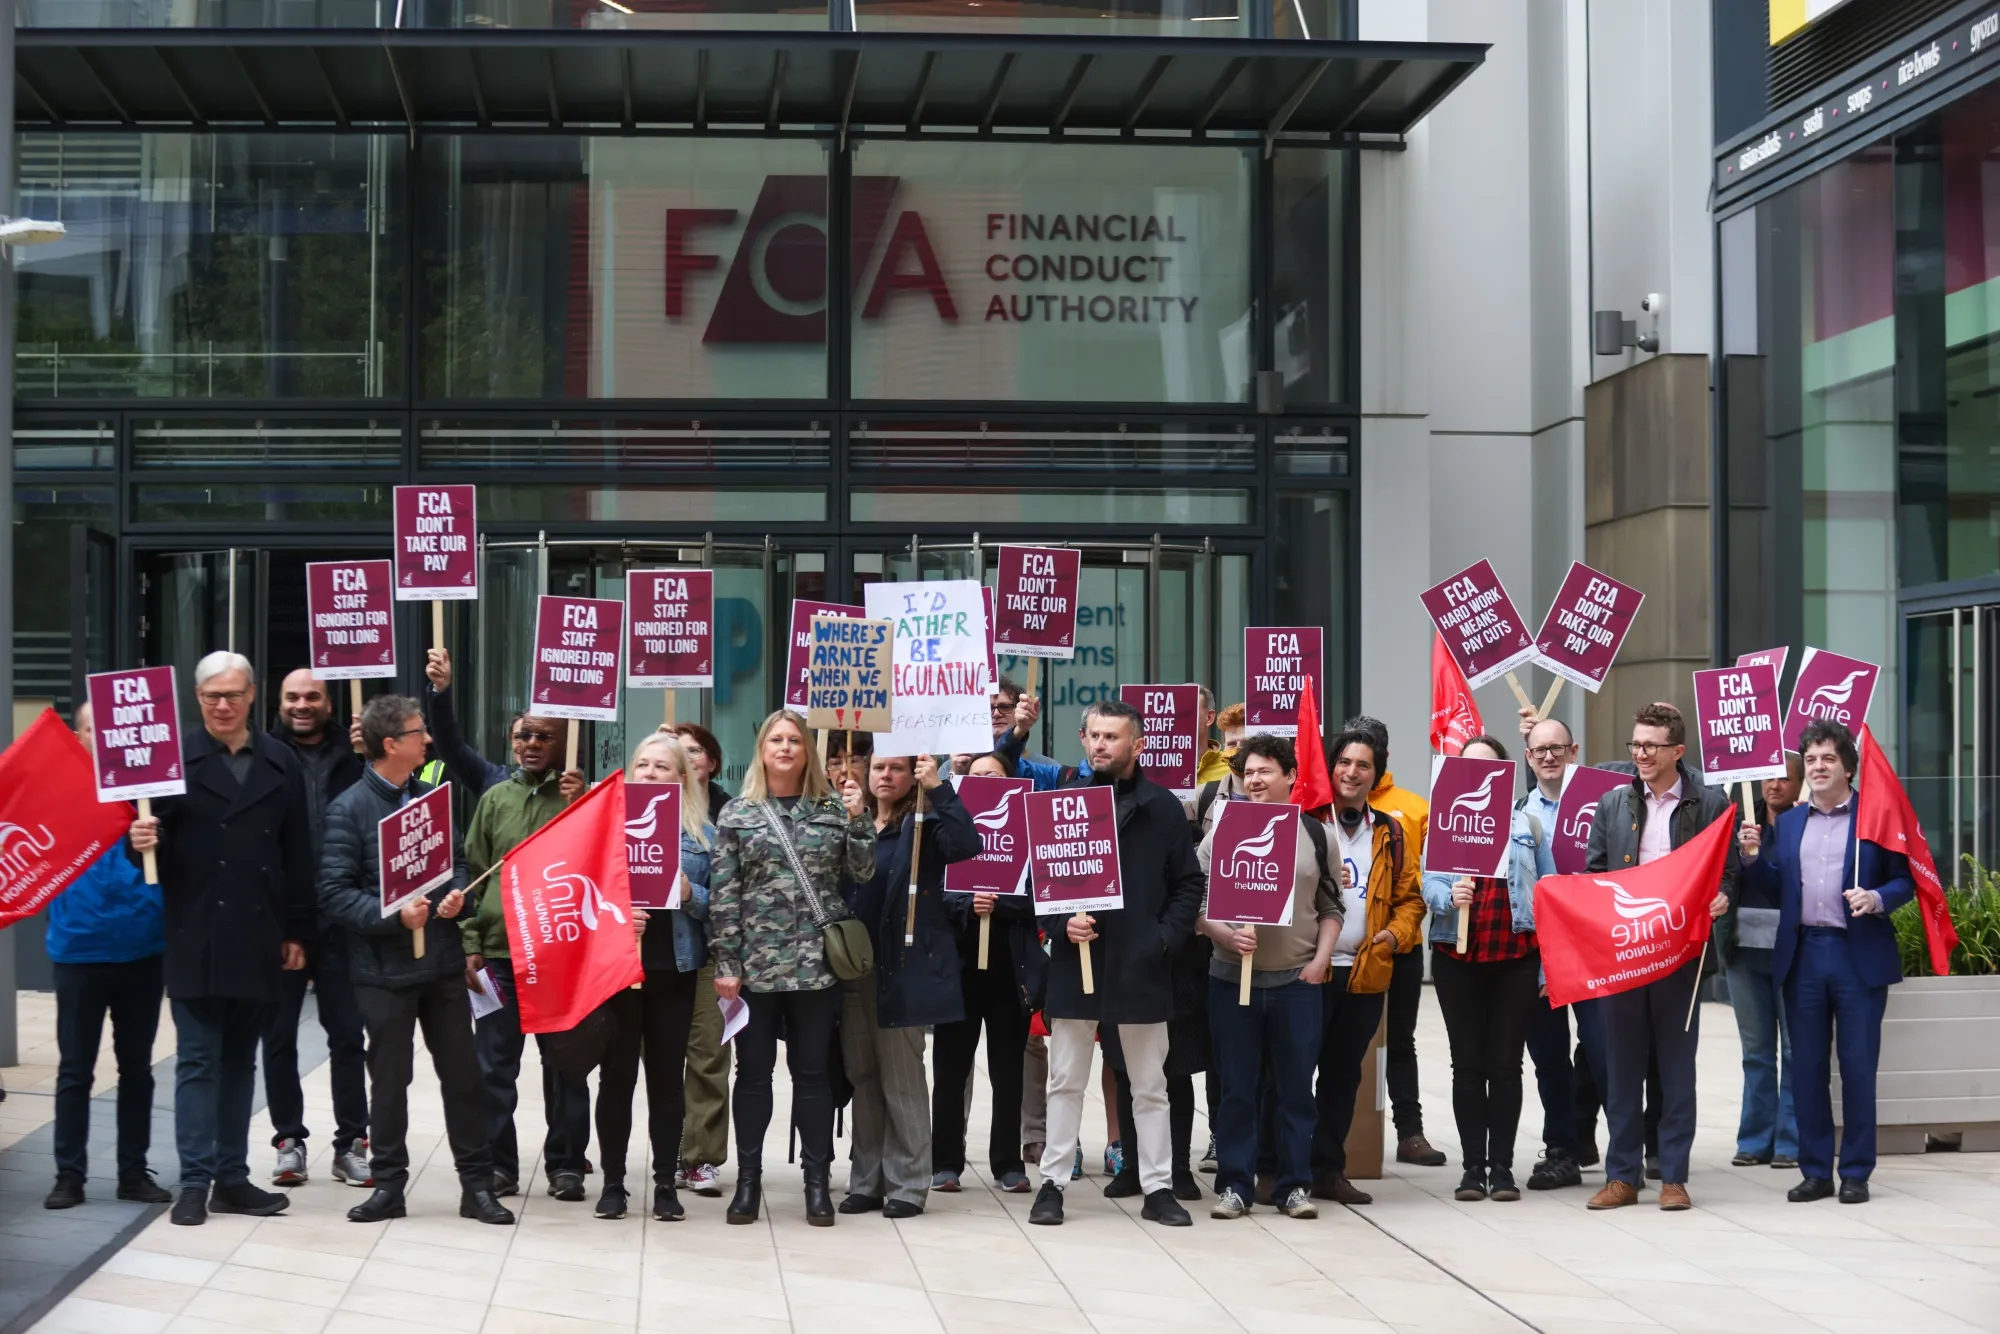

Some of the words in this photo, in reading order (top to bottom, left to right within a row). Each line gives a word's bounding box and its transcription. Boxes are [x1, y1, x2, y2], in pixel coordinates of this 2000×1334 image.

[1803, 107, 1823, 137] sushi
[1847, 85, 1871, 113] soups
[1898, 61, 1915, 85] rice
[1970, 12, 1999, 52] gyoza
[987, 214, 1186, 243] FINANCIAL
[665, 208, 958, 320] FCA
[984, 255, 1172, 283] CONDUCT
[984, 296, 1199, 322] AUTHORITY
[418, 492, 451, 514] FCA
[416, 516, 455, 533] DON'T
[405, 536, 438, 552] TAKE
[440, 535, 467, 552] OUR
[424, 555, 448, 571] PAY
[1023, 554, 1055, 576] FCA
[332, 569, 368, 591] FCA
[654, 578, 688, 600] FCA
[1019, 577, 1057, 594] DON'T
[334, 594, 368, 609] STAFF
[1443, 576, 1479, 607] FCA
[1584, 577, 1618, 608] FCA
[654, 604, 688, 618] STAFF
[1006, 594, 1038, 611] TAKE
[1041, 596, 1067, 613] OUR
[1439, 605, 1470, 630] HARD
[1468, 587, 1502, 613] WORK
[1574, 597, 1613, 625] DON'T
[316, 612, 364, 627] IGNORED
[366, 611, 388, 626] FOR
[563, 605, 598, 629] FCA
[882, 612, 972, 638] ATHER
[1023, 614, 1047, 630] PAY
[1459, 608, 1498, 638] MEANS
[1557, 608, 1589, 635] TAKE
[1587, 624, 1614, 648] OUR
[325, 631, 348, 645] TOO
[350, 629, 380, 644] LONG
[562, 631, 597, 647] STAFF
[635, 622, 683, 636] IGNORED
[686, 622, 707, 635] FOR
[1462, 635, 1484, 655] PAY
[1483, 620, 1512, 643] CUTS
[644, 639, 665, 653] TOO
[669, 639, 698, 653] LONG
[910, 638, 942, 662] BE
[1269, 634, 1299, 654] FCA
[1564, 633, 1591, 655] PAY
[541, 648, 590, 666] IGNORED
[592, 651, 614, 667] FOR
[813, 646, 878, 668] ARNIE
[1266, 657, 1302, 672] DON'T
[549, 667, 572, 682] TOO
[574, 669, 603, 684] LONG
[811, 669, 850, 687] WHEN
[858, 670, 881, 686] WE
[891, 662, 986, 697] EGULATING
[1255, 676, 1285, 691] TAKE
[1719, 673, 1754, 697] FCA
[113, 677, 152, 704] FCA
[811, 690, 848, 708] NEED
[852, 689, 887, 708] HIM
[1144, 692, 1175, 714] FCA
[1273, 694, 1295, 710] PAY
[1718, 697, 1757, 716] DON'T
[112, 704, 155, 726] DON'T
[1144, 718, 1175, 731] STAFF
[1708, 718, 1742, 736] TAKE
[1744, 714, 1771, 733] OUR
[102, 727, 140, 748] TAKE
[141, 724, 170, 744] OUR
[1144, 736, 1170, 749] ORED
[1172, 735, 1192, 749] FOR
[1729, 735, 1754, 754] PAY
[125, 747, 152, 767] PAY
[1139, 753, 1154, 767] OO
[1156, 753, 1182, 767] LONG
[401, 802, 431, 833] FCA
[1052, 796, 1088, 821] FCA
[399, 820, 434, 852] DON'T
[1054, 823, 1089, 840] STAFF
[1452, 835, 1494, 845] theUNION
[389, 845, 419, 872] TAKE
[421, 831, 444, 855] OUR
[1036, 842, 1086, 860] IGNORED
[1089, 840, 1112, 856] FOR
[406, 856, 428, 880] PAY
[1047, 862, 1070, 878] TOO
[1072, 859, 1103, 875] LONG
[1235, 882, 1278, 892] theUNION
[531, 888, 554, 944] theUNION
